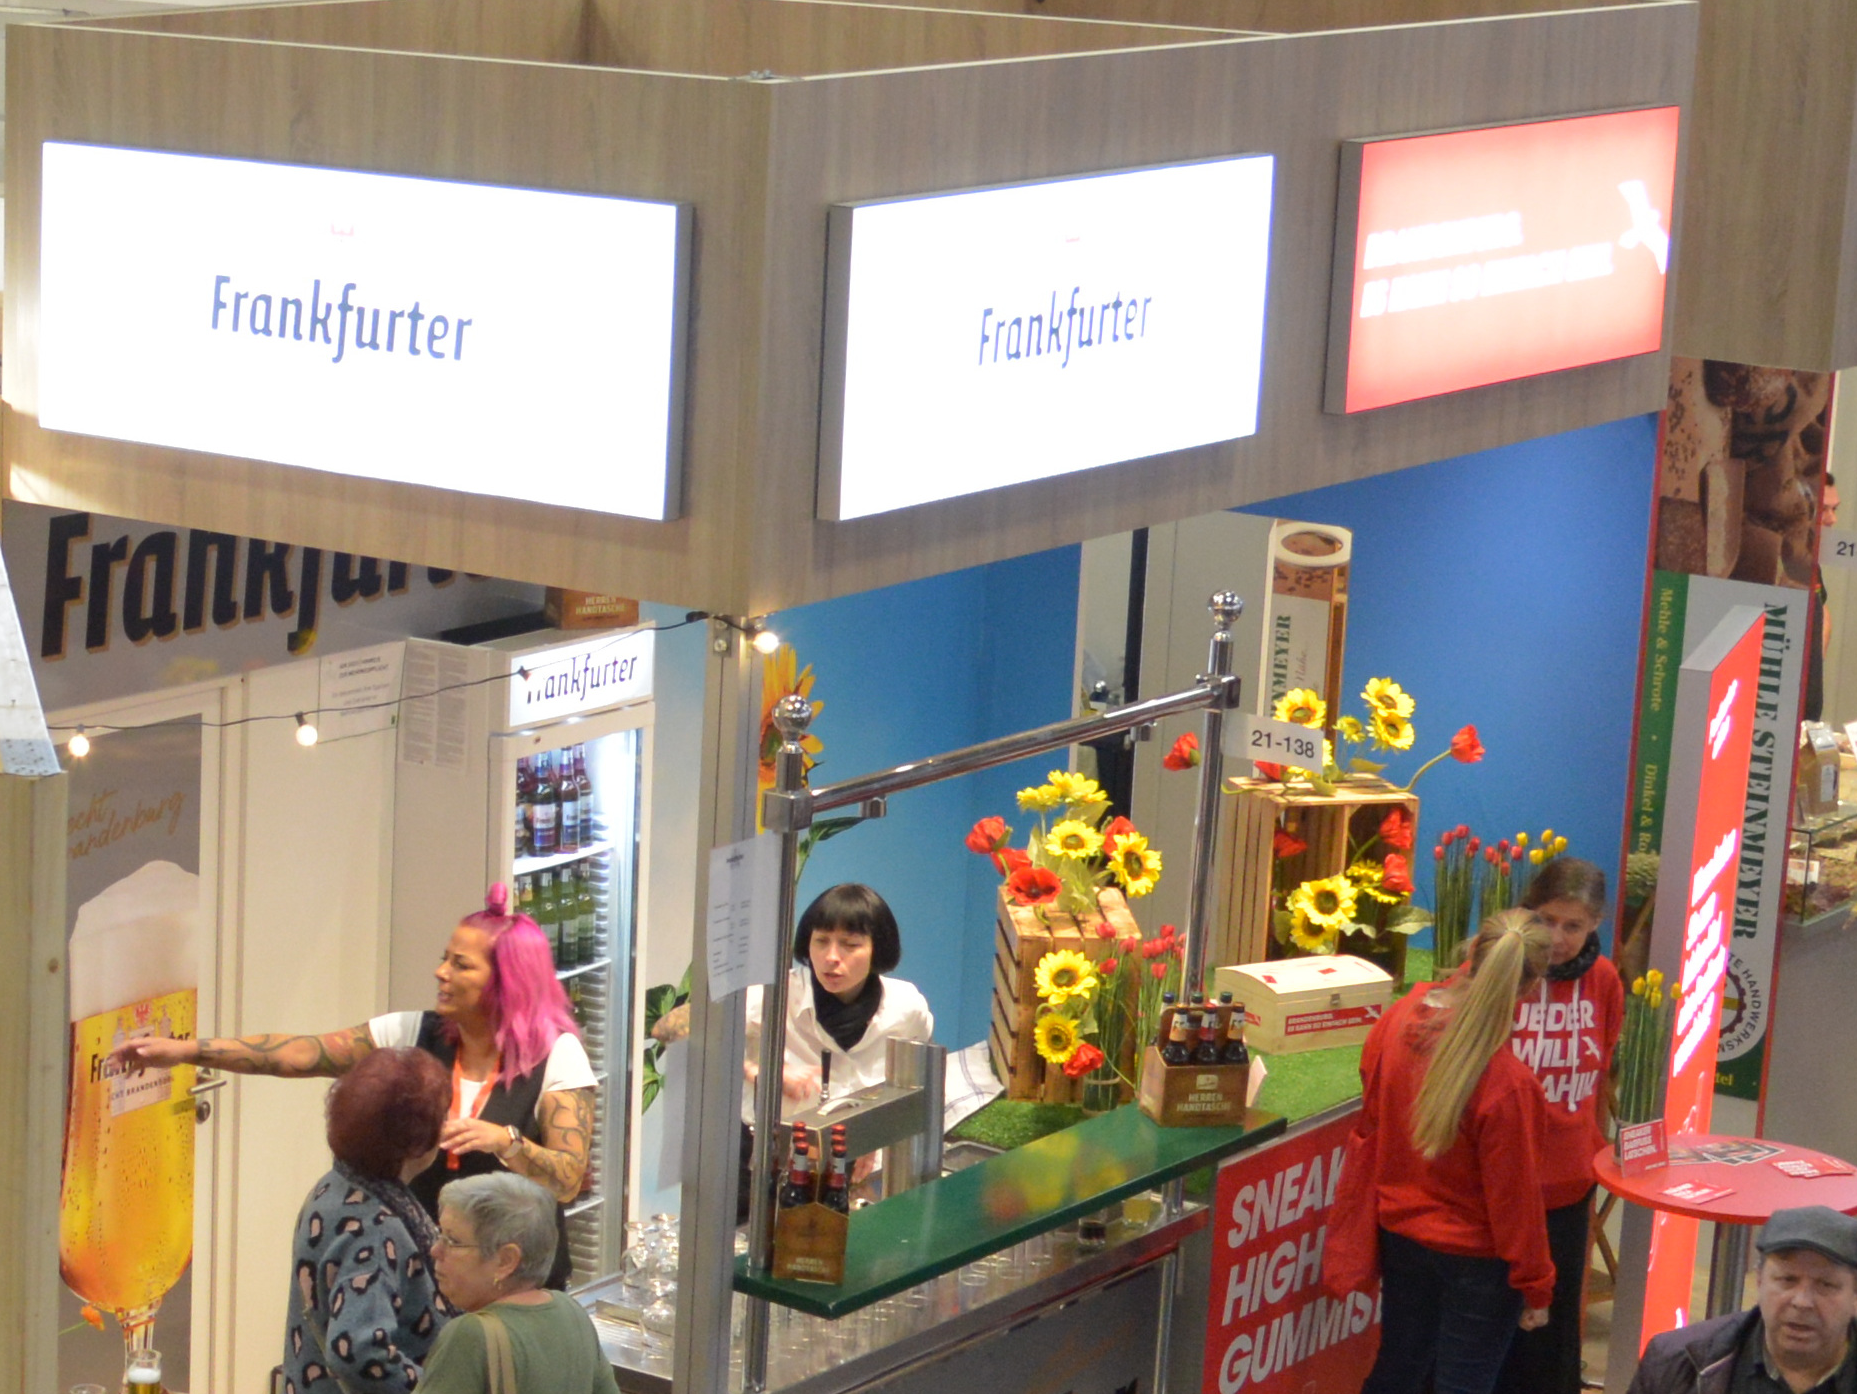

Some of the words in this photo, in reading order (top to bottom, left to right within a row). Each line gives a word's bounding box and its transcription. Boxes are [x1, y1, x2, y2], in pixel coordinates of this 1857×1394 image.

[211, 274, 473, 364] Frankfurter
[978, 286, 1153, 369] Frankfurter
[1655, 588, 1674, 634] Mehle
[1271, 615, 1291, 716] NMEYER
[1650, 653, 1668, 712] Schrote
[1754, 602, 1792, 722] MÜHLE
[1251, 729, 1315, 760] 21-138
[1642, 763, 1658, 810] Dinkel
[1731, 728, 1776, 940] STEINMEYER
[1512, 1000, 1595, 1032] JEDER
[1512, 1038, 1580, 1068] WILL
